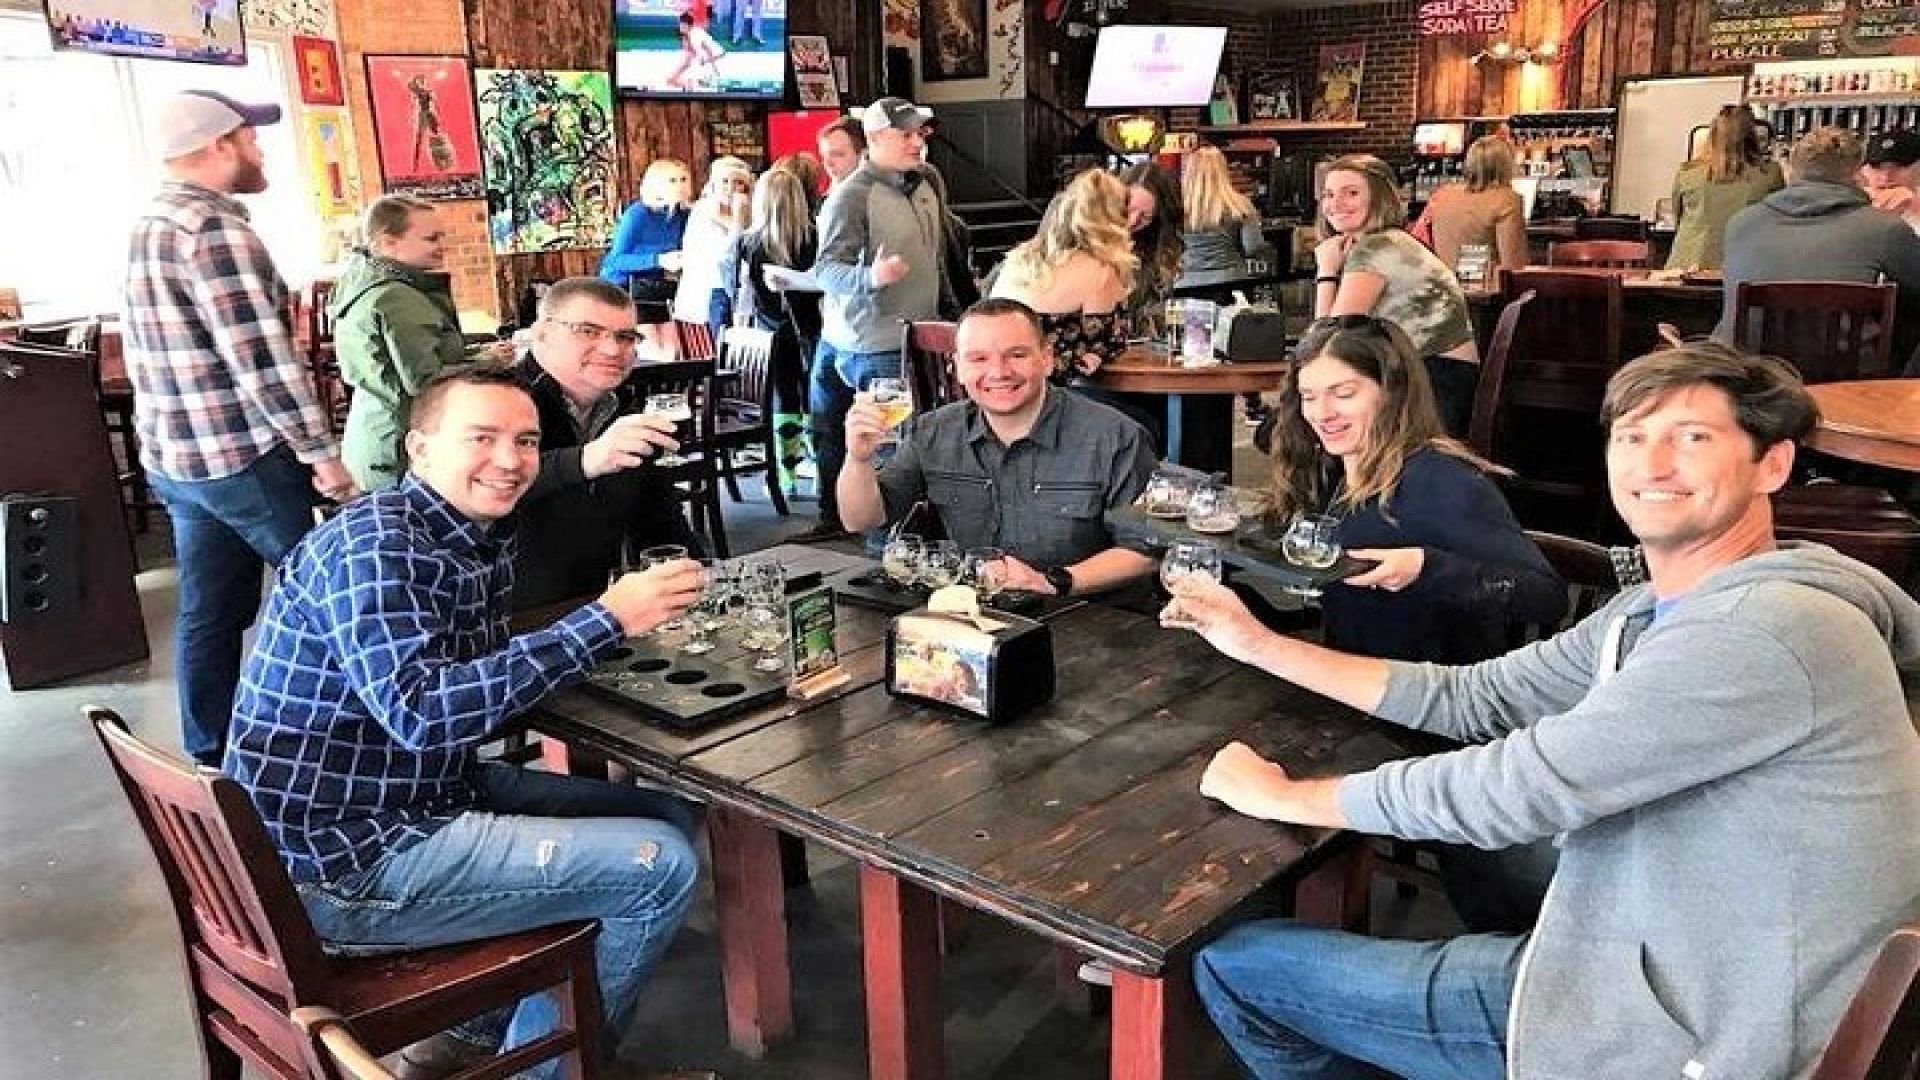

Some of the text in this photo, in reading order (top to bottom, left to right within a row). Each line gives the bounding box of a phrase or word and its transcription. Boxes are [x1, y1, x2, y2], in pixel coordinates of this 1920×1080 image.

[1419, 0, 1516, 18] SELF SERVE
[1422, 14, 1509, 34] SODA TEA
